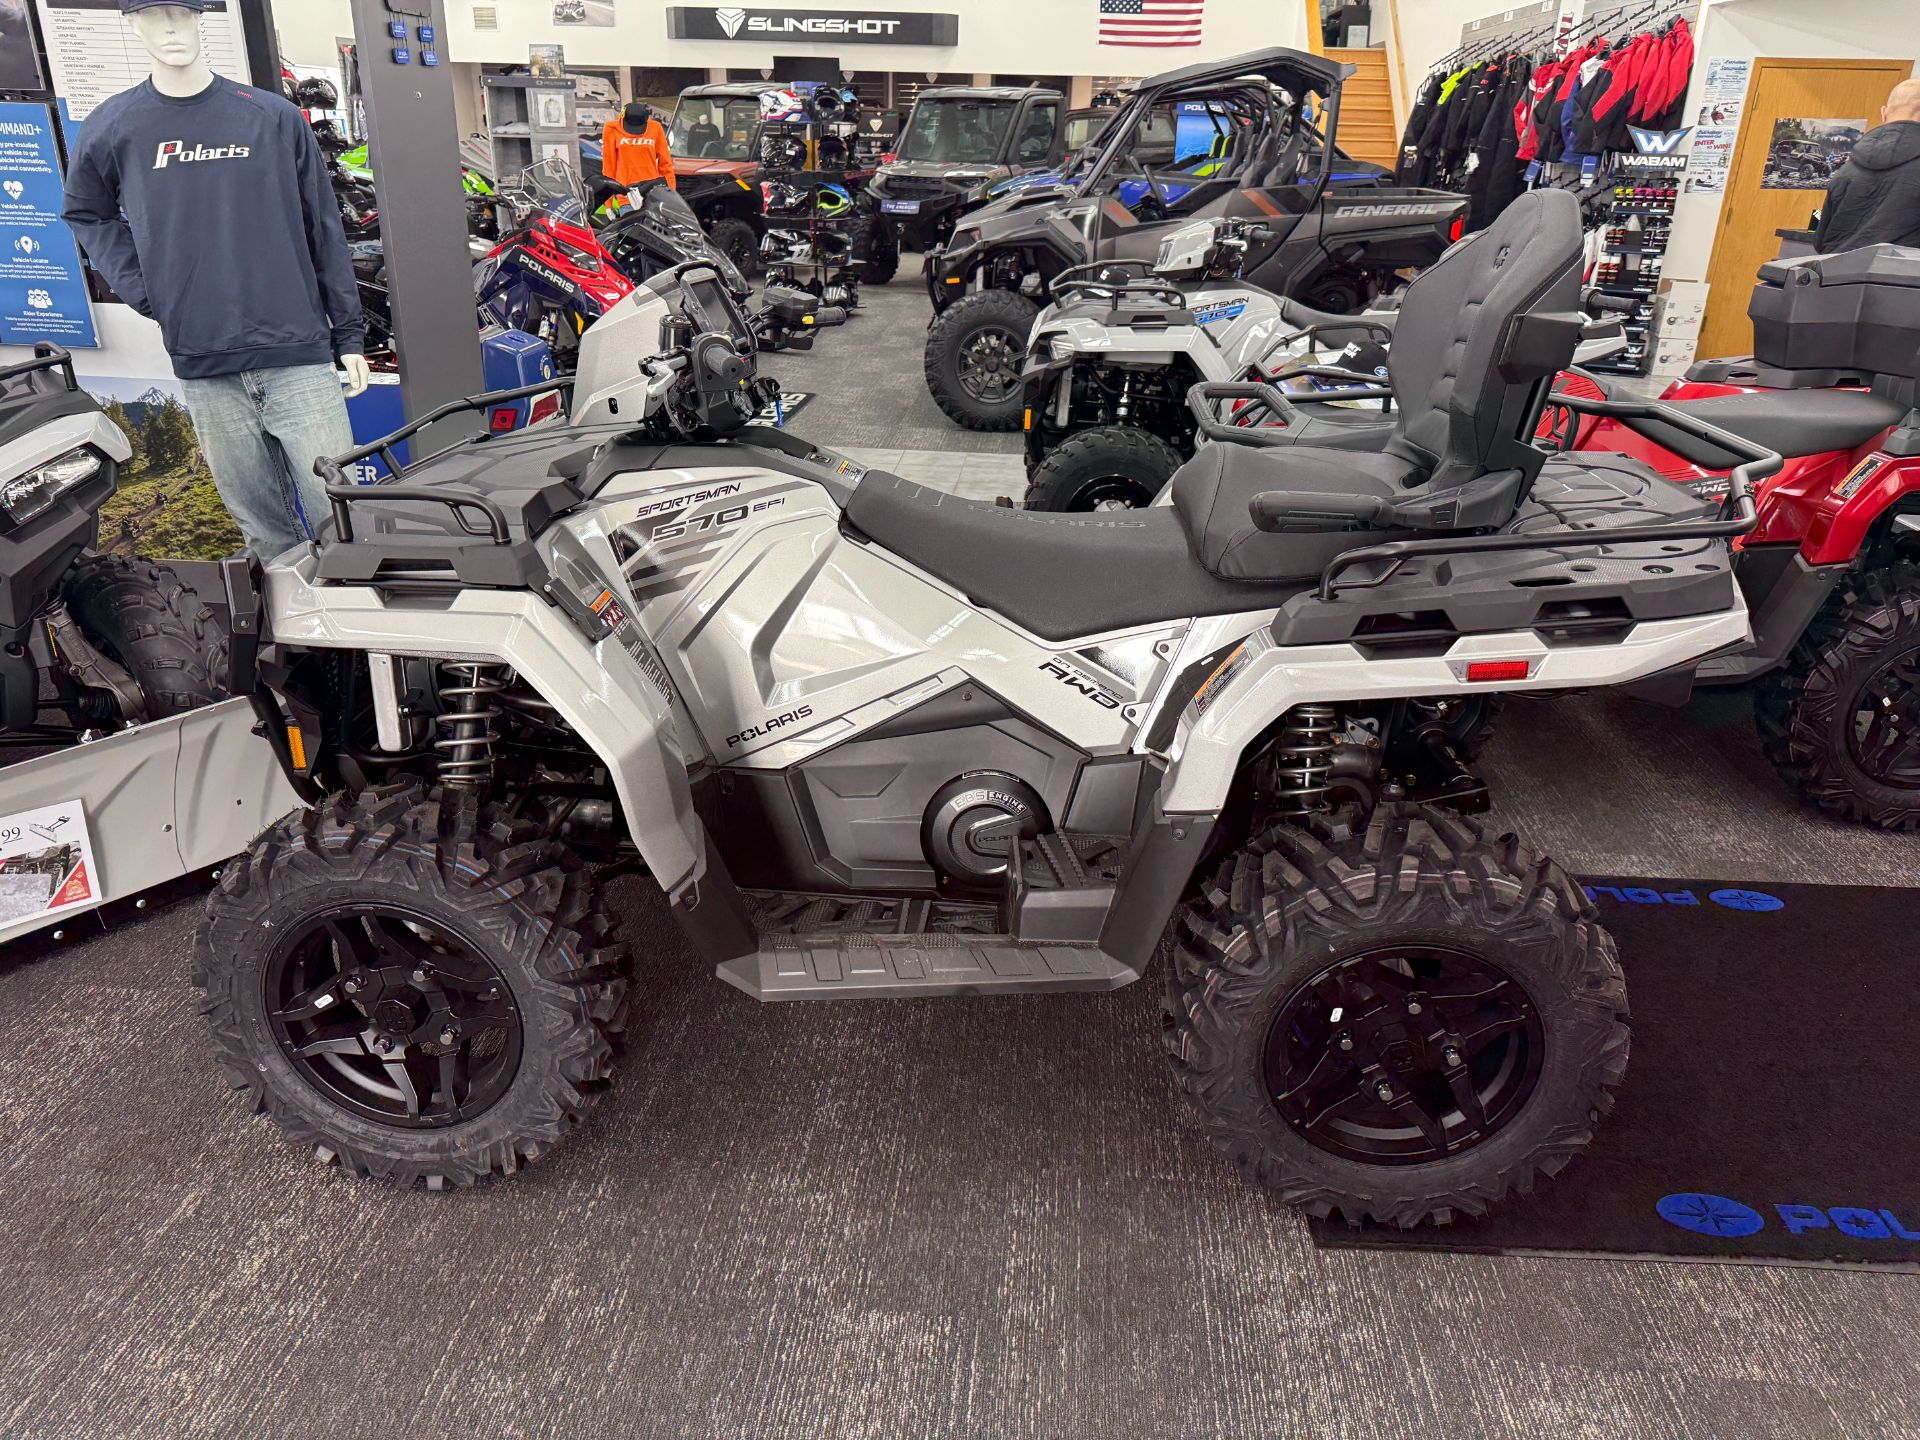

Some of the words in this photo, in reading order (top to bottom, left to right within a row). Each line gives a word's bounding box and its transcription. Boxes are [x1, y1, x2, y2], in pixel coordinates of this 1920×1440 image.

[747, 17, 900, 34] SLINGSHOT
[152, 140, 250, 169] Polaris
[1694, 139, 1714, 147] ENTER
[1621, 155, 1686, 167] WABAM
[1333, 203, 1438, 218] GENERAL
[518, 254, 575, 294] POLARIS
[1190, 296, 1249, 314] PORTSMAN
[637, 482, 741, 517] SPORTSMAN
[653, 505, 749, 543] 570
[753, 497, 785, 513] EFI
[1038, 661, 1120, 710] AWD
[1053, 657, 1071, 669] ON
[1073, 669, 1124, 700] DEMAND
[726, 704, 813, 748] POLARIS
[988, 790, 1027, 813] ENGINE
